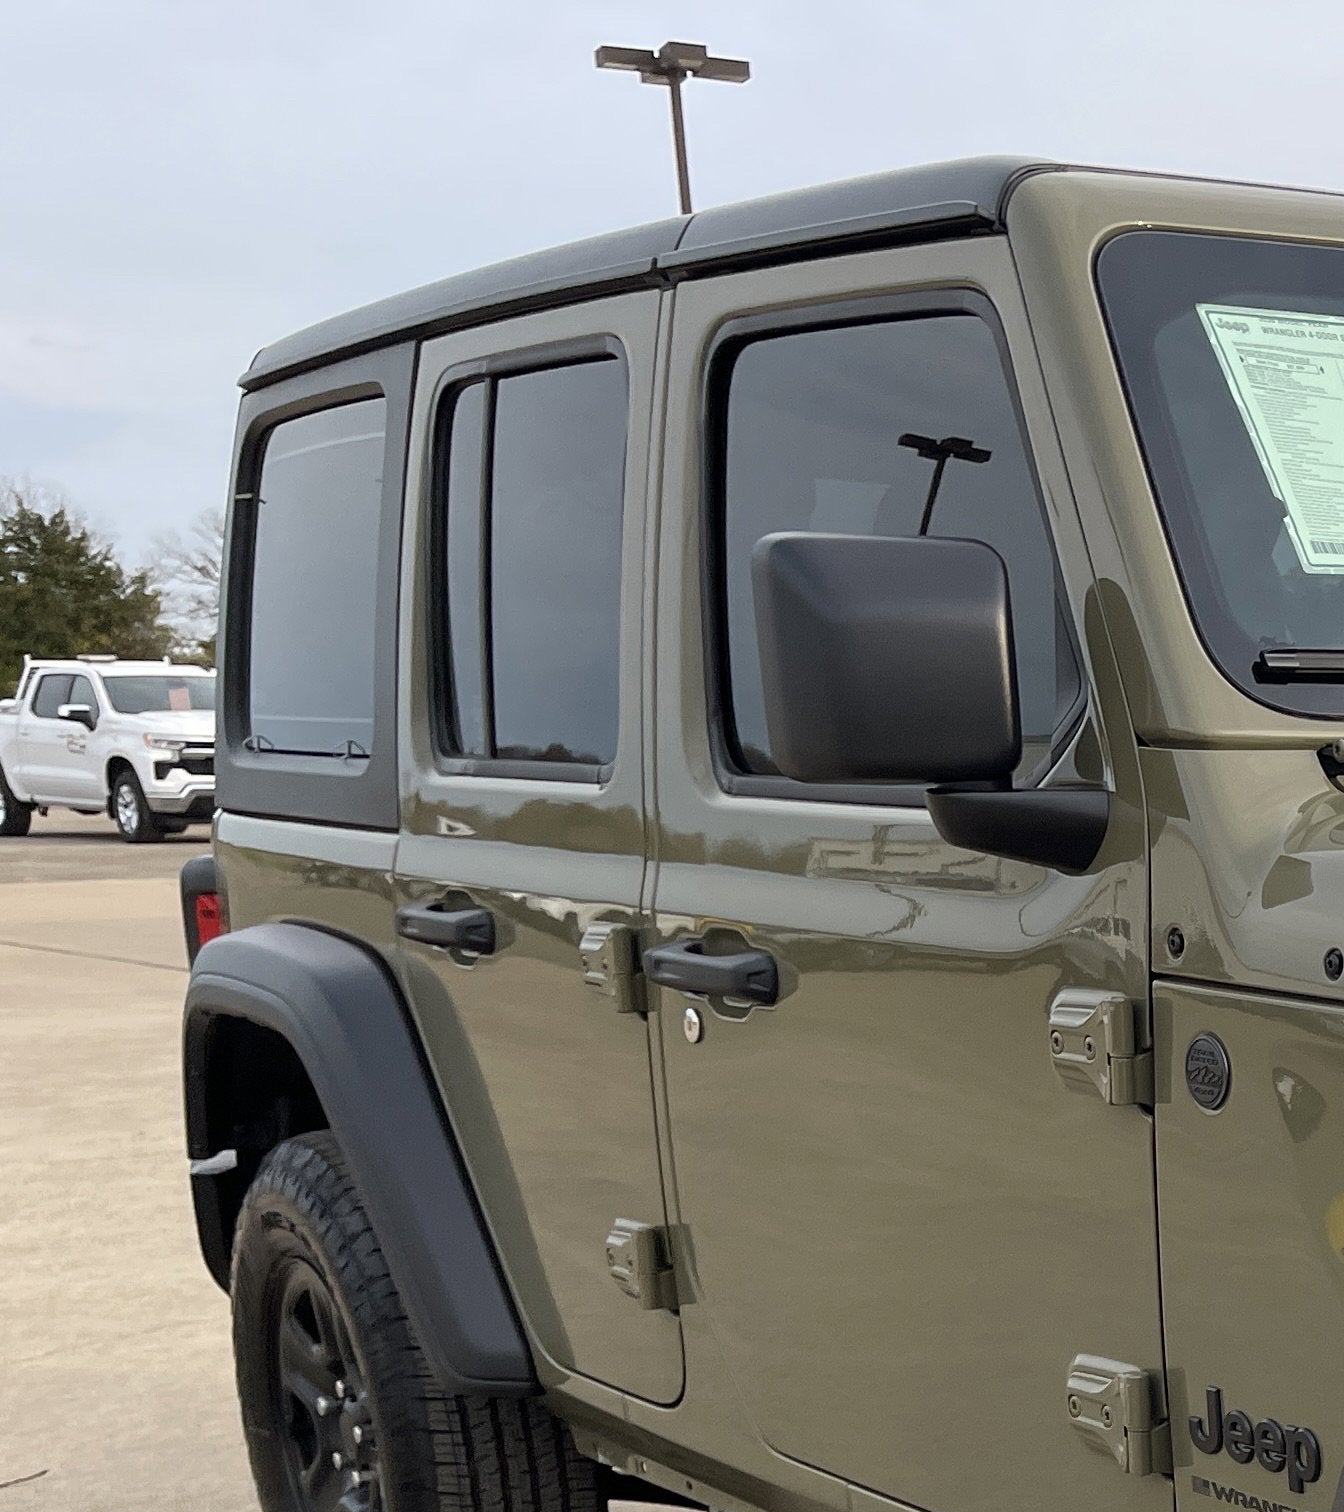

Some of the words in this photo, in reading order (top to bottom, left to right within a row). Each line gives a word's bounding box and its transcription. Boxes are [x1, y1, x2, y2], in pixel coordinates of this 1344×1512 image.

[1215, 318, 1250, 334] Jeep
[1261, 326, 1308, 340] WRANGLER
[1308, 331, 1340, 342] 4-DOOR
[1189, 1385, 1322, 1494] Jeep
